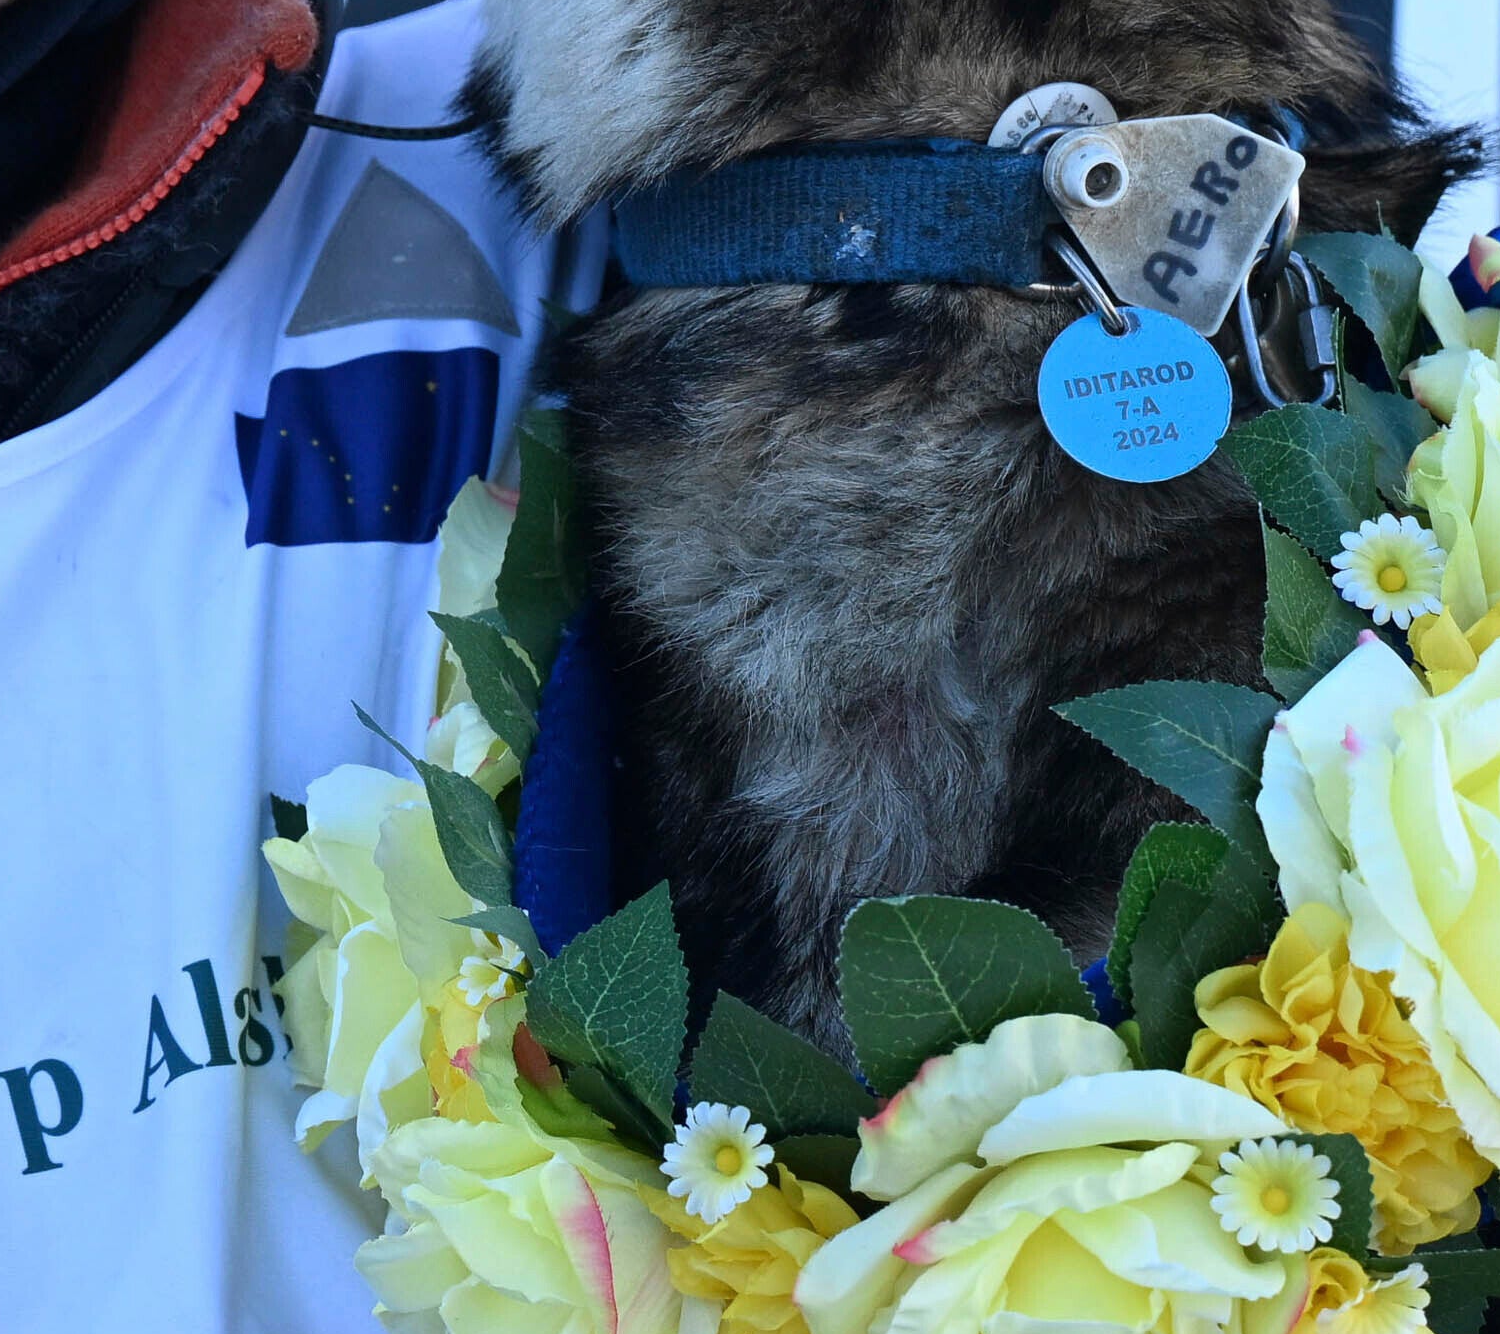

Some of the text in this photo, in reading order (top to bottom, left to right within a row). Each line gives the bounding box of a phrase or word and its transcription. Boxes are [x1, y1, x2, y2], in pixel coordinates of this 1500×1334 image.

[1063, 360, 1195, 401] IDITAROD
[1115, 395, 1161, 422] 7-A
[1113, 422, 1180, 453] 2024
